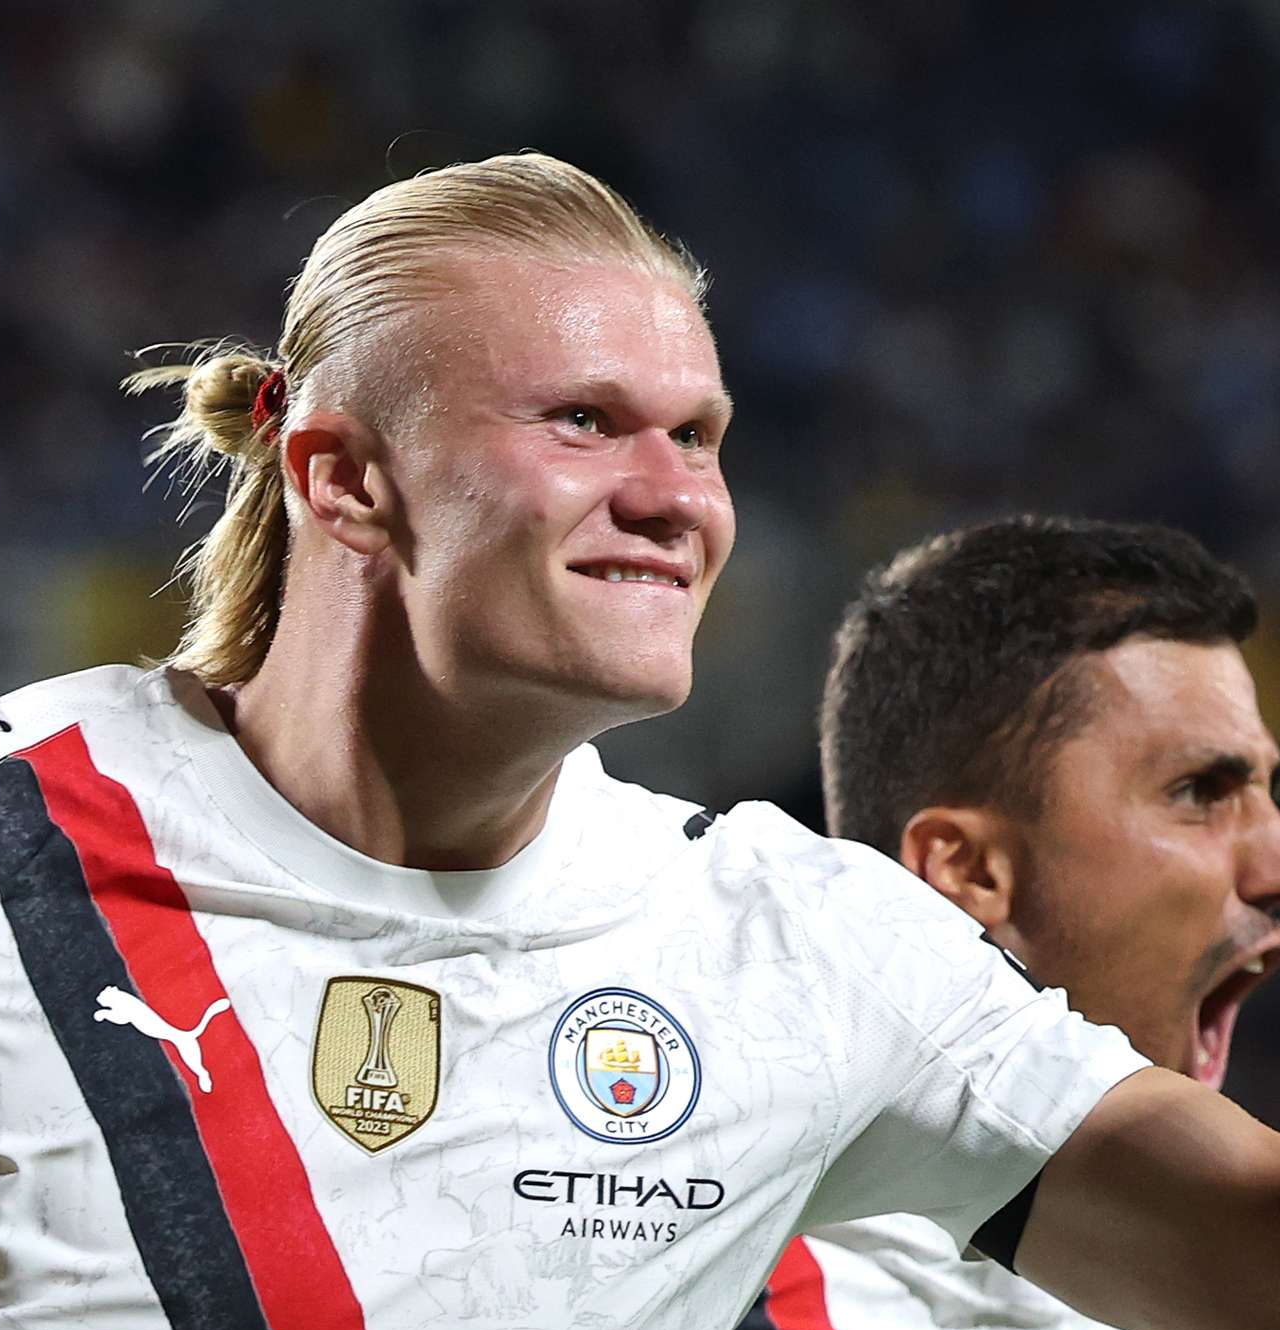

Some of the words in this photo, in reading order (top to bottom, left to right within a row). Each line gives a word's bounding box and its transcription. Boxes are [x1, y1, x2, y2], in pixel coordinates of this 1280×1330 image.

[564, 1000, 680, 1052] MANCHESTER
[346, 1086, 405, 1114] FIFA
[333, 1107, 364, 1118] WORLD
[364, 1108, 418, 1124] CHAMPIONS
[356, 1119, 390, 1136] 2023
[605, 1120, 650, 1134] CITY
[513, 1168, 726, 1211] ETIHAD
[560, 1217, 678, 1243] AIRWAYS
